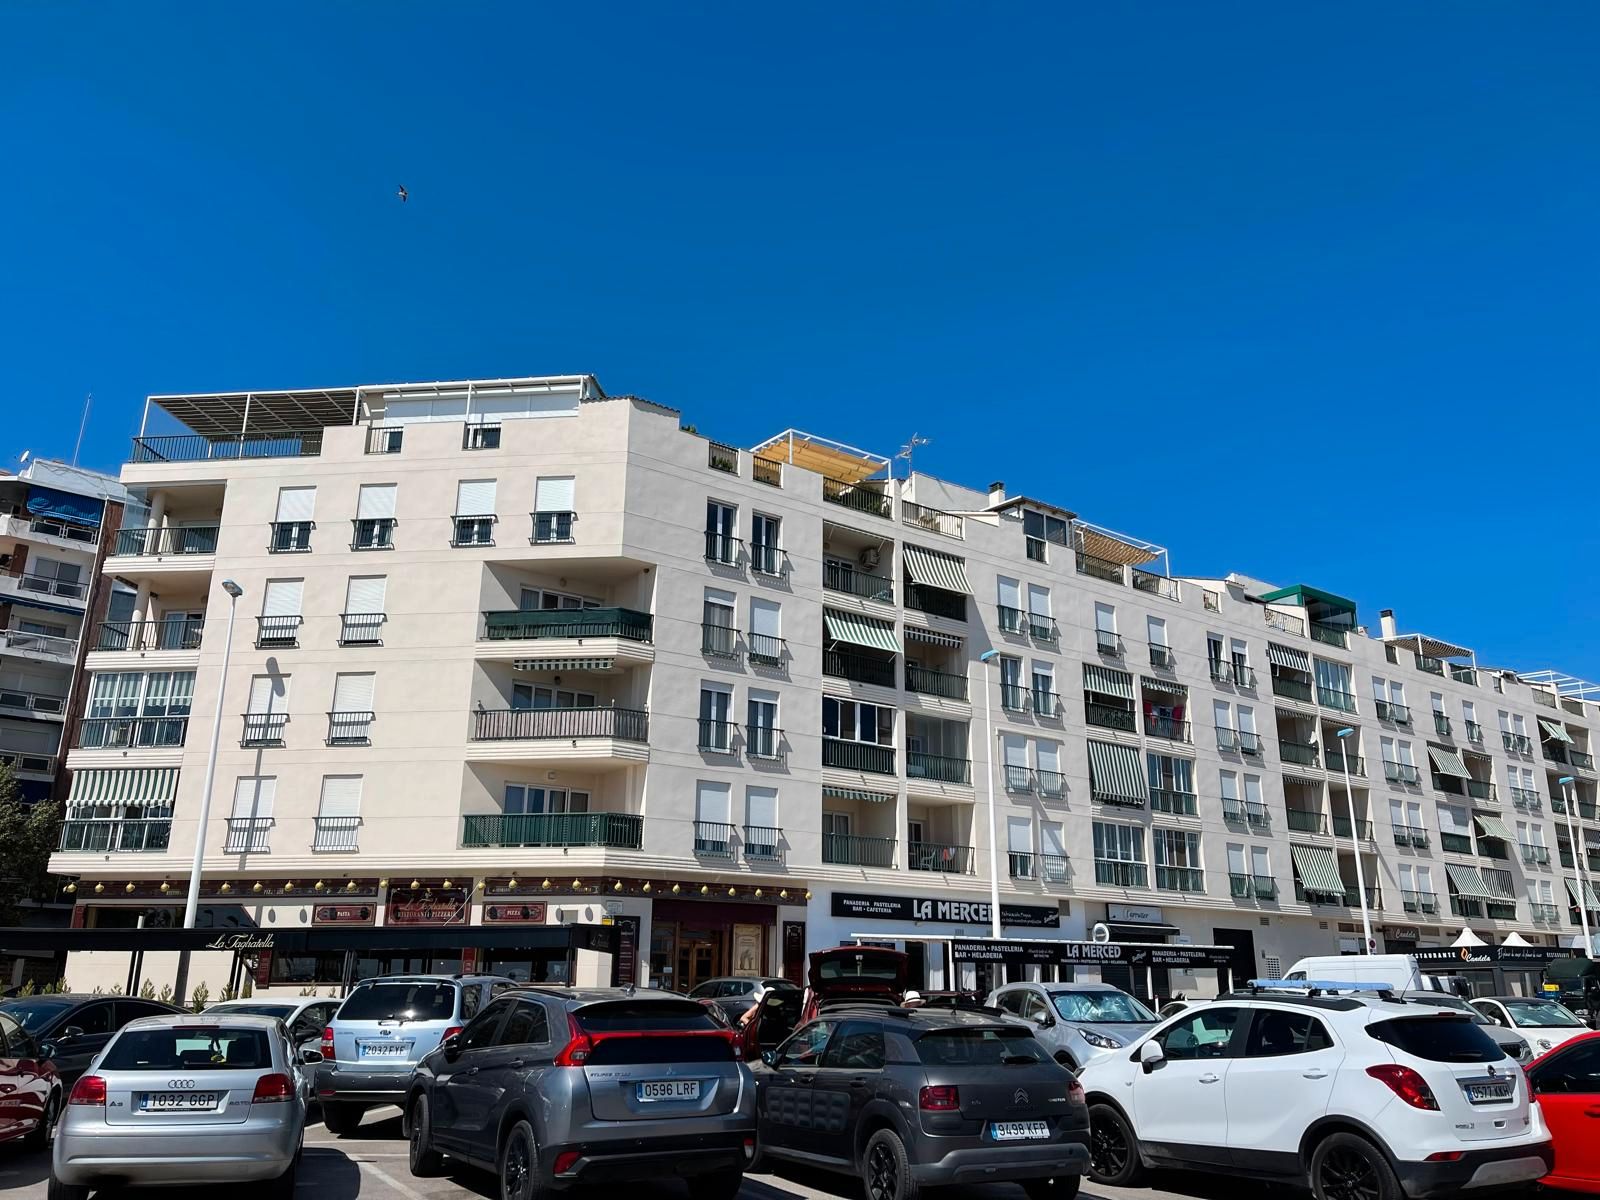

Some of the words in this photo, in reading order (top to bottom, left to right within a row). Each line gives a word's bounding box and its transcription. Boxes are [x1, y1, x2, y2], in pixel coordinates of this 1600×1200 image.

[913, 899, 932, 920] LA
[205, 933, 225, 949] La
[225, 933, 274, 950] Tagliatella
[954, 944, 986, 952] PANADERIA
[990, 945, 1024, 953] PASTELERIA
[1066, 944, 1079, 958] LA
[1082, 944, 1121, 959] MERCED
[366, 1045, 387, 1055] 2032
[644, 1084, 673, 1096] 0596
[676, 1082, 697, 1096] LRF
[1472, 1086, 1492, 1098] 0577
[152, 1094, 184, 1107] 1032
[189, 1094, 215, 1106] GGP
[999, 1123, 1025, 1136] 9498
[1027, 1122, 1046, 1134] KFP
